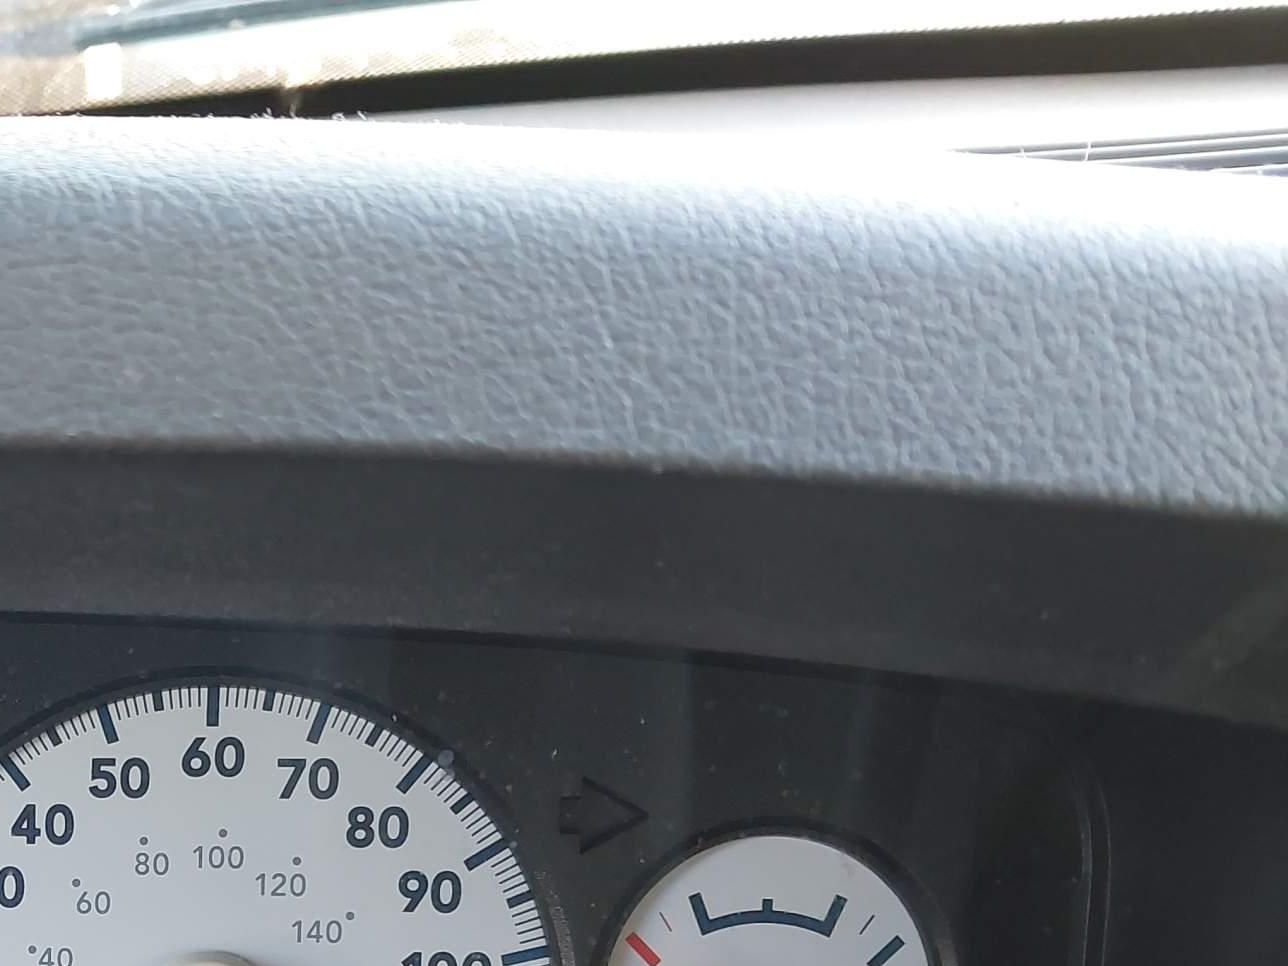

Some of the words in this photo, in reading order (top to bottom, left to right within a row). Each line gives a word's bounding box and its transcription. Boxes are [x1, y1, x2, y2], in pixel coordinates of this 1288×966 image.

[181, 737, 246, 778] 60
[88, 758, 150, 799] 50
[277, 758, 340, 799] 70
[11, 804, 74, 845] 40
[346, 806, 410, 848] 80
[134, 852, 169, 876] 80
[193, 846, 245, 870] 100
[76, 891, 111, 915] 60
[255, 873, 307, 897] 120
[398, 871, 462, 912] 90
[292, 921, 342, 943] 140
